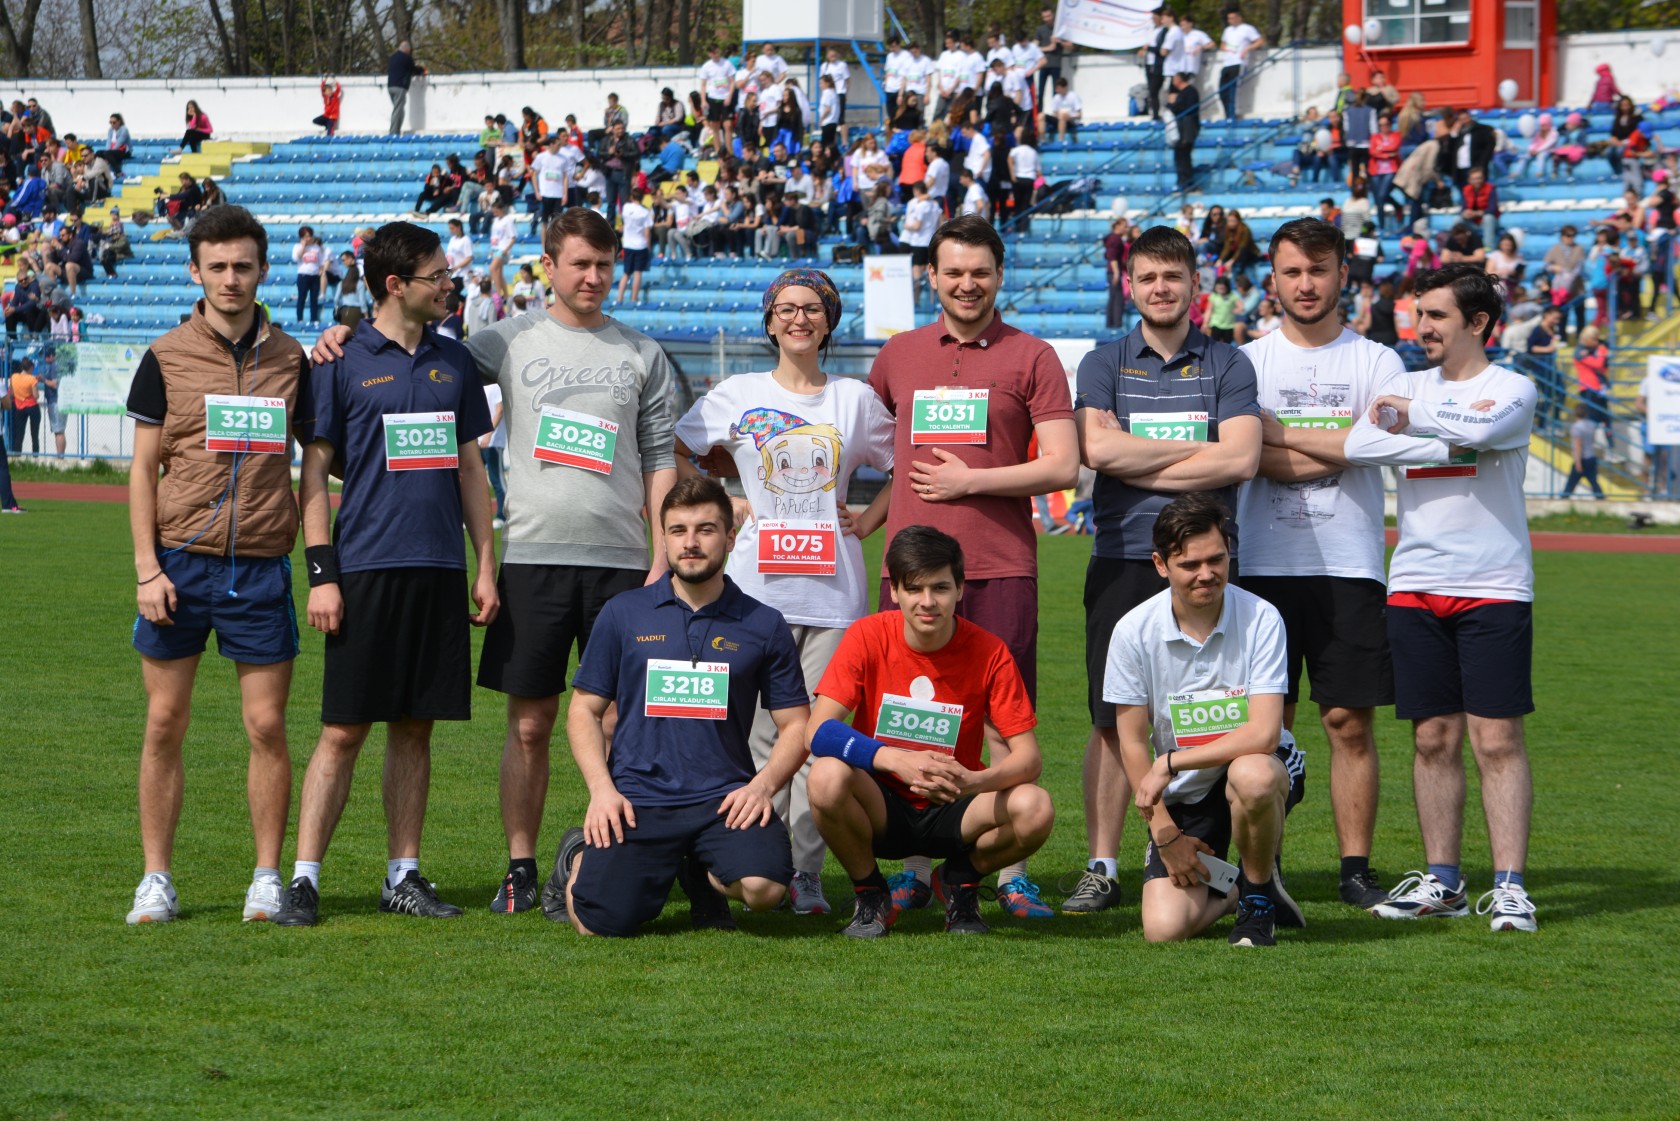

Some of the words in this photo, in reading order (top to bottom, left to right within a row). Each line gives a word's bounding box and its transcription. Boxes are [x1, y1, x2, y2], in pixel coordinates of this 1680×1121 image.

[521, 357, 637, 392] Great
[613, 385, 627, 401] 86
[220, 410, 273, 430] 3219
[442, 414, 454, 422] KM
[924, 404, 975, 422] 3031
[598, 420, 604, 428] 3
[604, 422, 617, 432] KM
[395, 428, 448, 447] 3025
[547, 422, 607, 450] 3028
[546, 441, 565, 450] BACIU
[566, 445, 604, 458] ALEXANDRU
[770, 534, 823, 553] 1075
[706, 664, 712, 672] 3
[714, 665, 728, 673] KM
[661, 675, 715, 696] 3218
[1230, 688, 1245, 696] KM
[679, 697, 722, 705] VLADUT-EMIL
[940, 705, 946, 713] 3
[947, 707, 961, 715] KM
[1178, 702, 1241, 726] 5006
[887, 710, 951, 736] 3048
[886, 729, 912, 738] ROTARU
[914, 733, 946, 743] CRISTINEL
